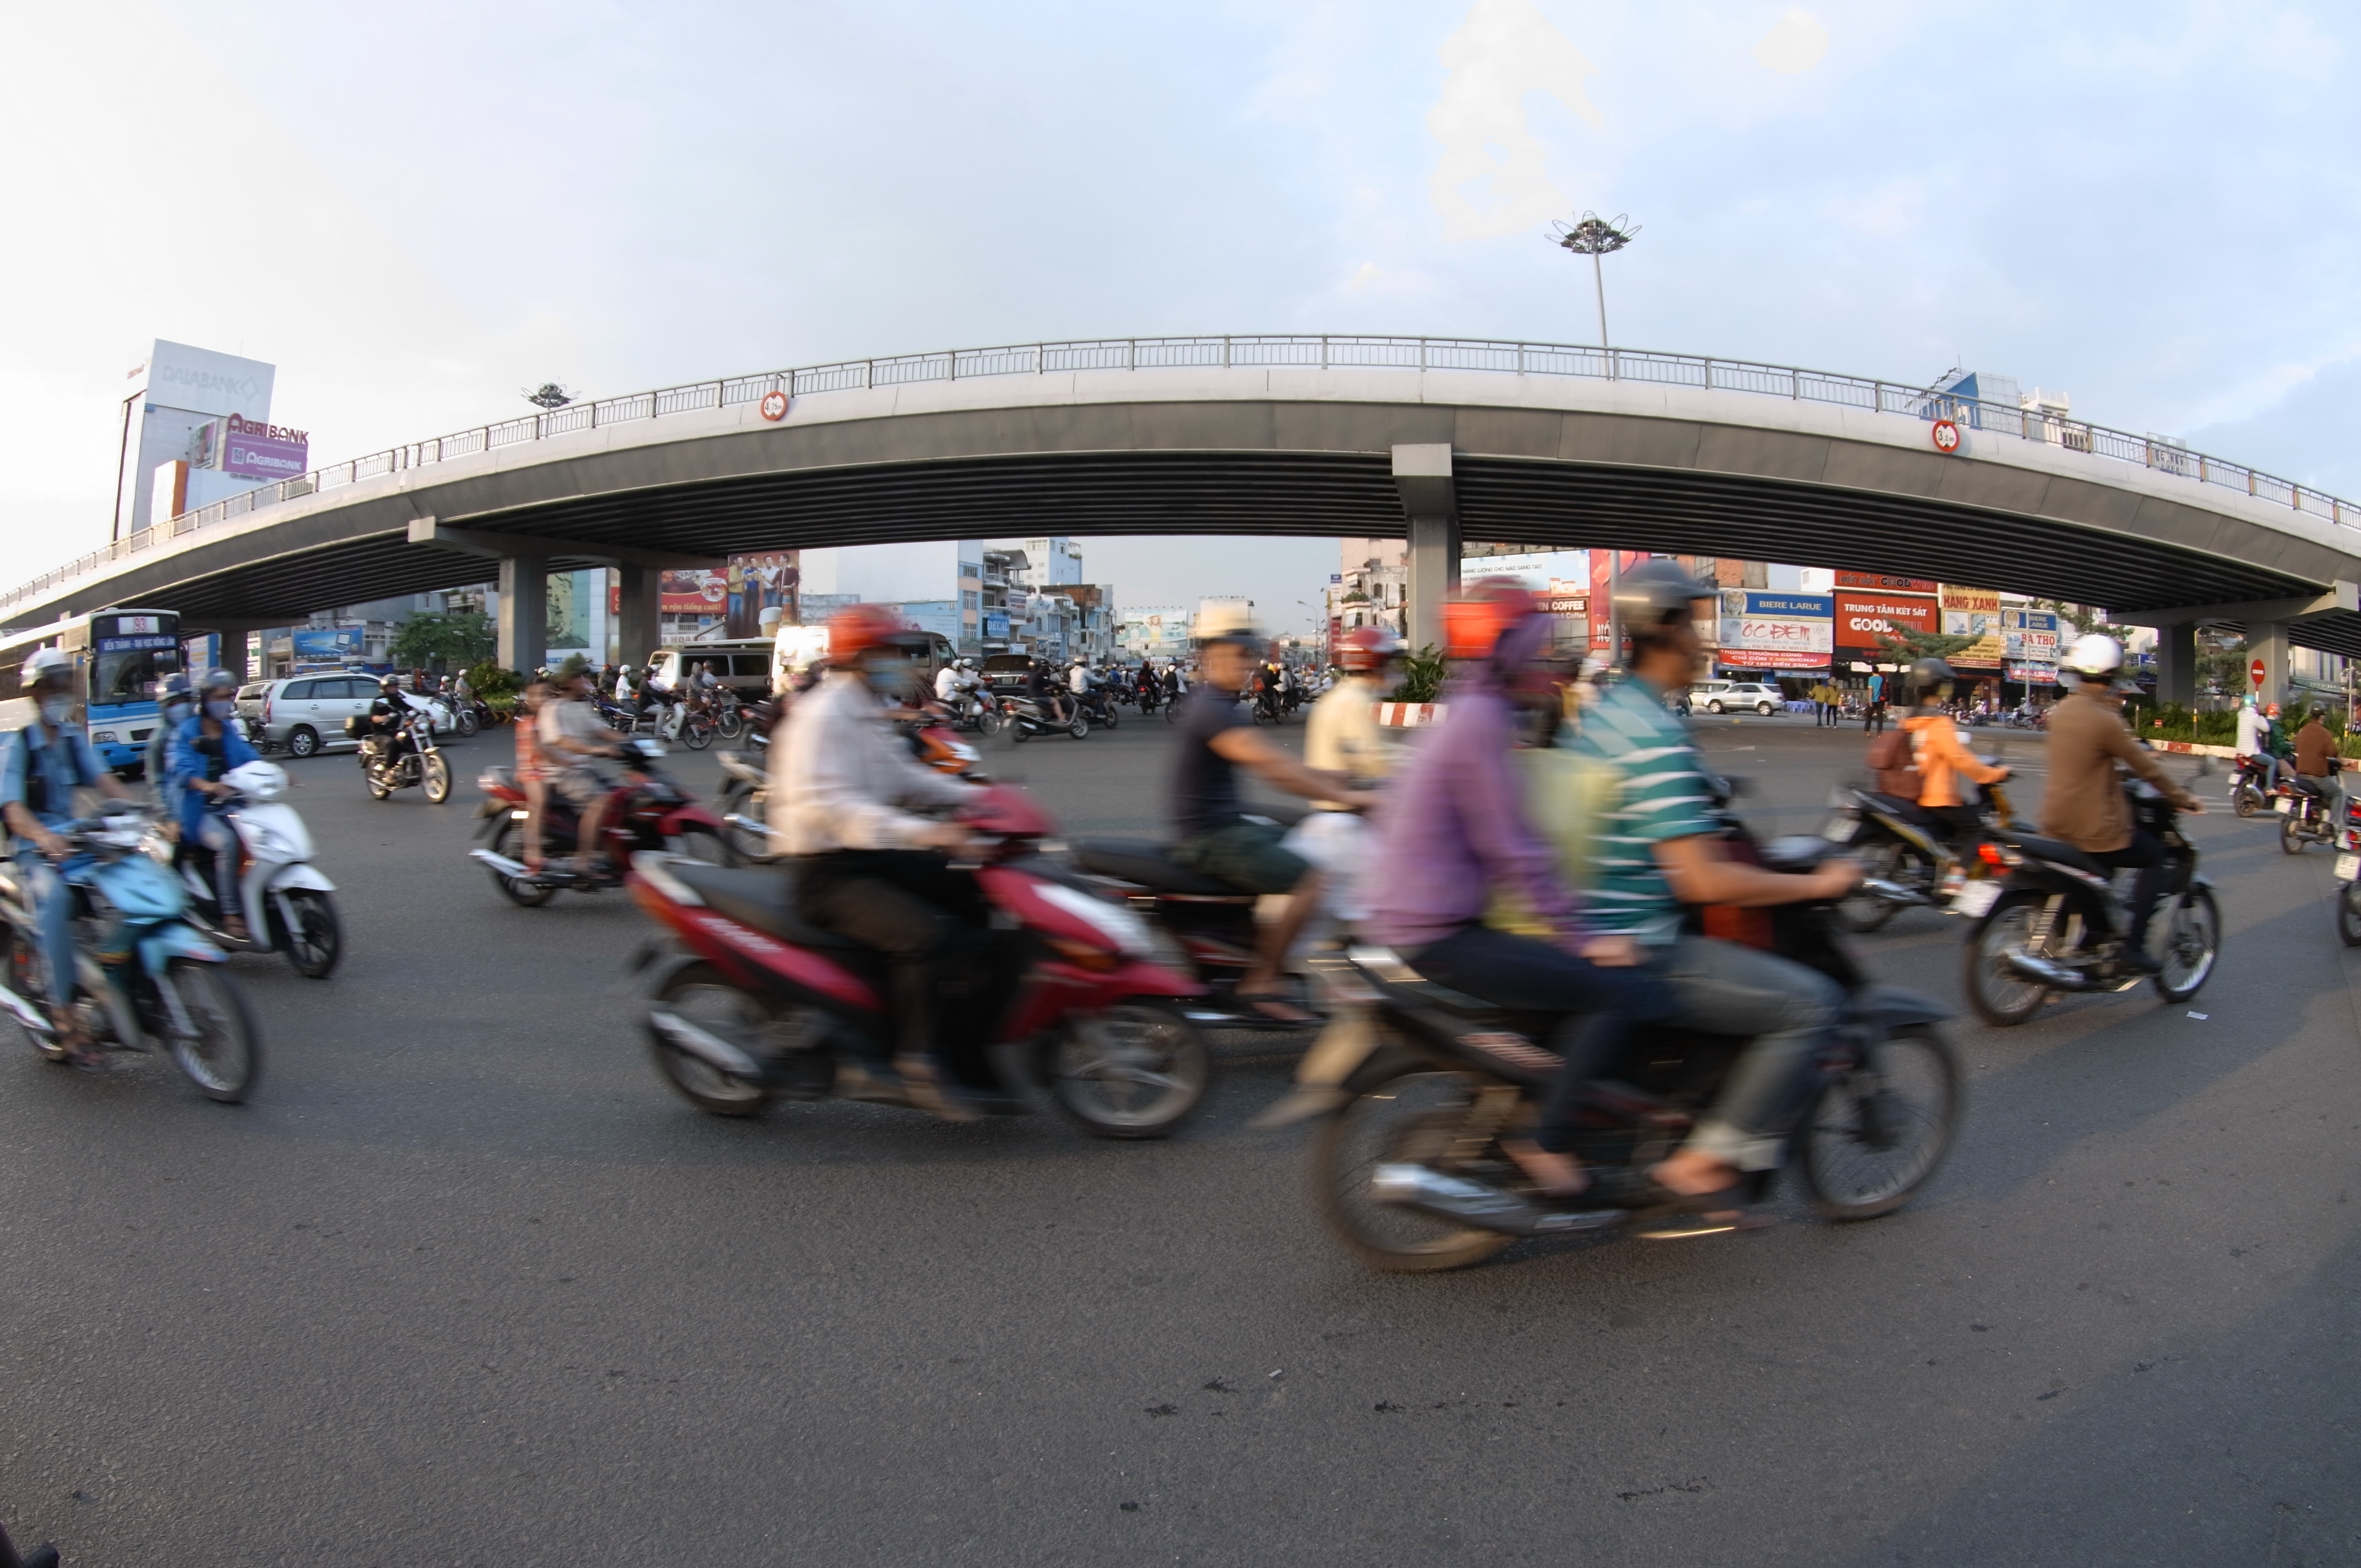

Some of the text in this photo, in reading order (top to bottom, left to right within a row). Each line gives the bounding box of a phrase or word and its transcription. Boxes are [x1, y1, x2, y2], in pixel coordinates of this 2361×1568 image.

[227, 413, 309, 444] AGRIBANK
[246, 451, 302, 471] AGRIBANK
[683, 602, 701, 611] tiếng
[1552, 600, 1585, 611] COFFEE
[1759, 600, 1822, 611] BIERE LARUE
[1845, 603, 1875, 613] TRUNG
[1876, 604, 1895, 615] TÂM
[1972, 596, 1998, 611] XANH
[135, 617, 145, 631] 93
[987, 620, 1009, 631] DECAL
